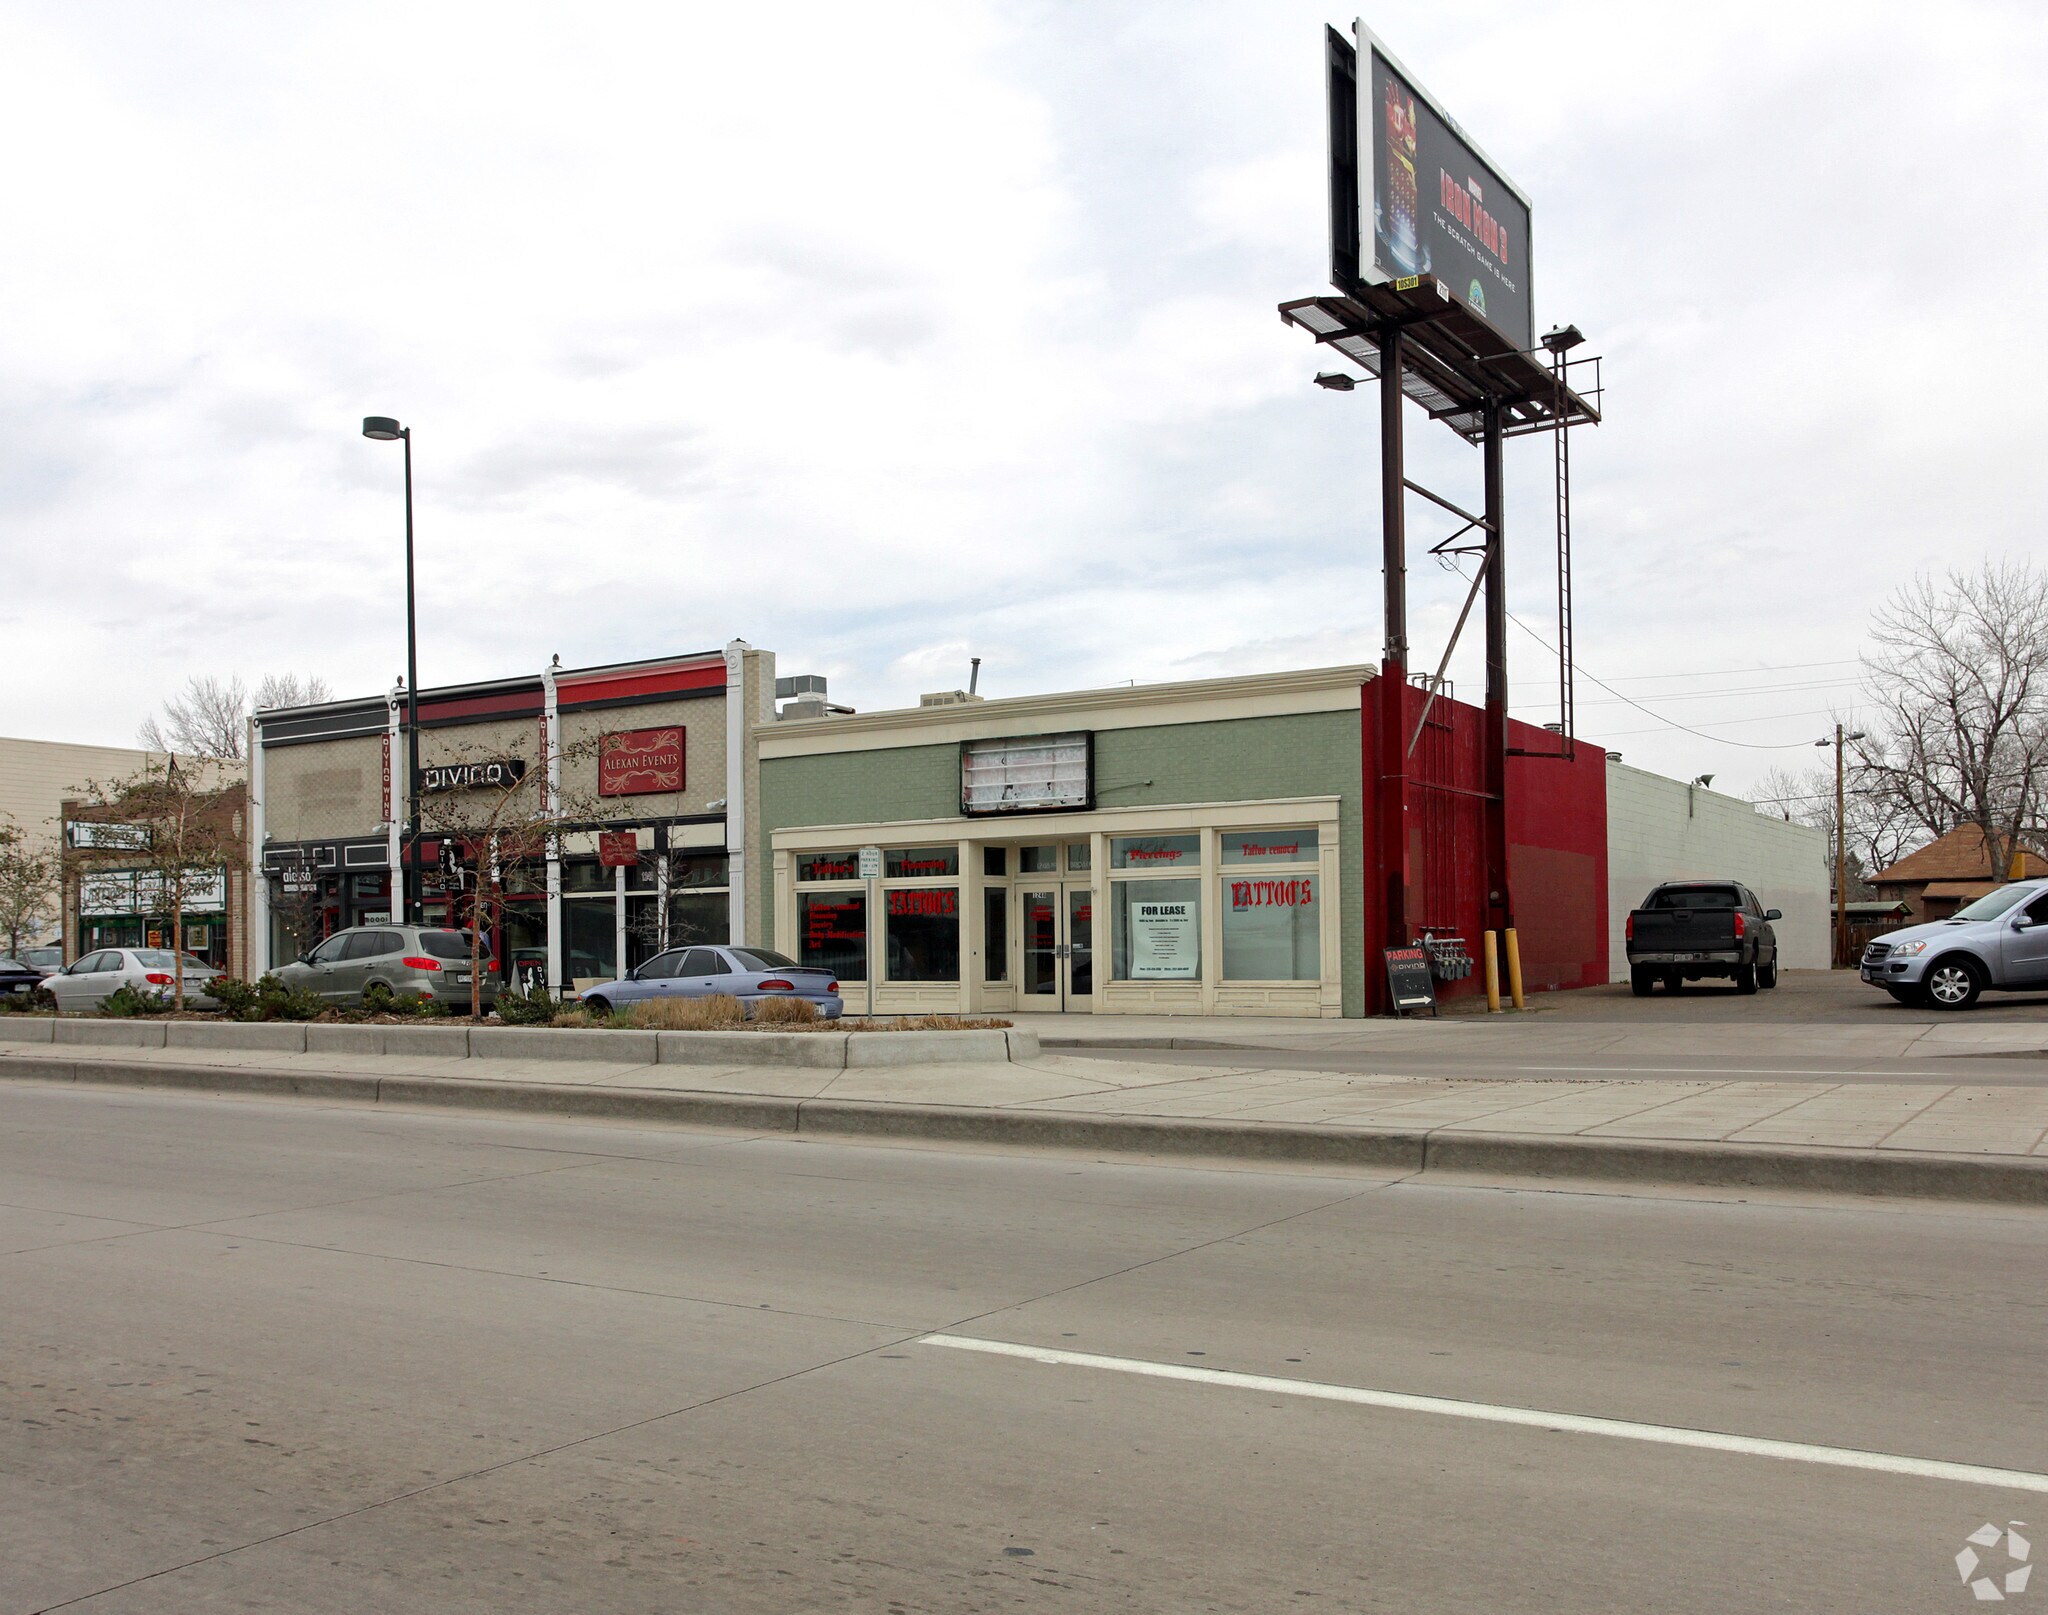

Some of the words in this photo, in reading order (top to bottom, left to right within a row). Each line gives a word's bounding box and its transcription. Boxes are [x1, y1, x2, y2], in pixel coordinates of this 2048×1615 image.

[1440, 167, 1471, 231] IRON
[1473, 199, 1498, 257] MAN
[1500, 226, 1507, 265] 3
[1433, 211, 1446, 230] THE
[1447, 225, 1475, 256] SCRATCH
[1476, 251, 1493, 272] GAME
[1494, 266, 1500, 279] IS
[1501, 274, 1516, 293] HERE
[1242, 843, 1267, 857] Tattoo
[1268, 841, 1299, 856] removal
[1231, 879, 1312, 908] TATTOO'S
[1141, 906, 1158, 915] FOR
[1160, 905, 1186, 915] LEASE
[1386, 948, 1424, 961] PARKING
